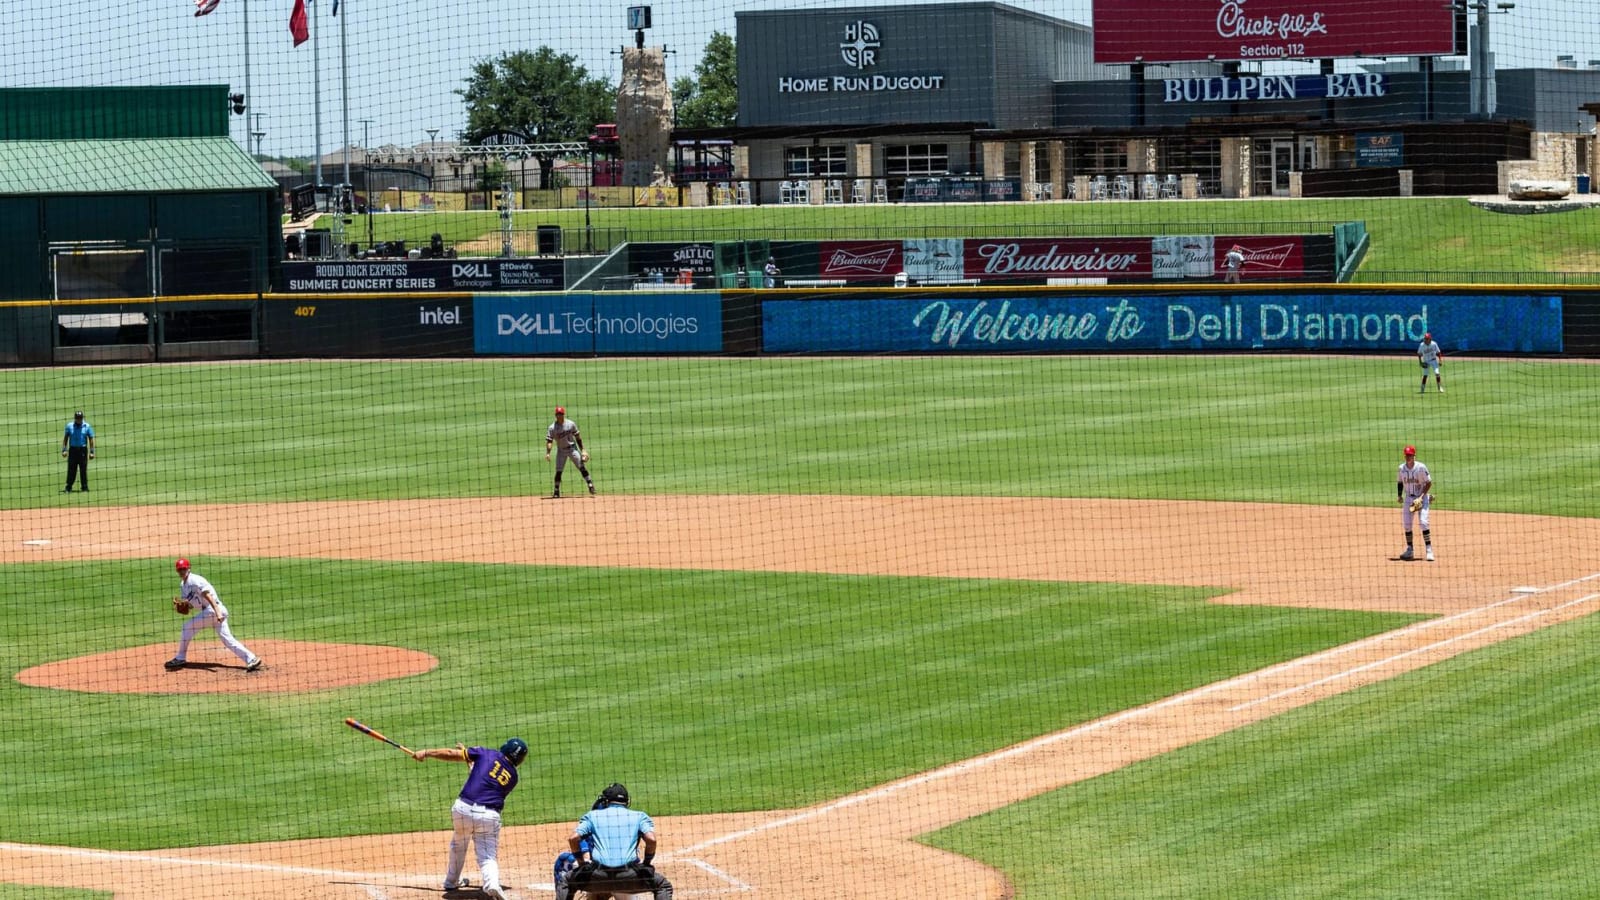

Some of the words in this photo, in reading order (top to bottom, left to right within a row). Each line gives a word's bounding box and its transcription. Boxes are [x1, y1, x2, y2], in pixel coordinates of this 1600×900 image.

[1217, 2, 1327, 39] Chick-fil-A
[1240, 44, 1284, 56] Section
[1287, 43, 1304, 55] 112
[779, 77, 828, 92] HOME
[833, 76, 869, 91] RUN
[873, 75, 943, 90] DUGOUT
[1164, 76, 1296, 102] BULLPEN
[1325, 73, 1384, 98] BAR
[673, 248, 696, 262] SALT
[831, 254, 887, 266] Budweiser
[978, 243, 1137, 274] Budweiser
[1242, 250, 1287, 261] udweiser
[316, 265, 344, 277] ROUND
[346, 264, 368, 277] ROCK
[370, 264, 408, 276] EXPRESS
[452, 264, 492, 277] DELL
[290, 279, 338, 290] SUMMER
[342, 279, 393, 290] CONCERT
[396, 278, 436, 289] SERIES
[453, 279, 492, 287] Technologies
[294, 306, 316, 316] 407
[498, 314, 562, 336] DELL
[561, 313, 698, 339] Technologies
[913, 300, 1099, 348] Welcome
[1106, 299, 1146, 343] to
[1168, 303, 1243, 341] Dell
[1260, 303, 1428, 341] Diamond
[489, 760, 512, 786] 15
